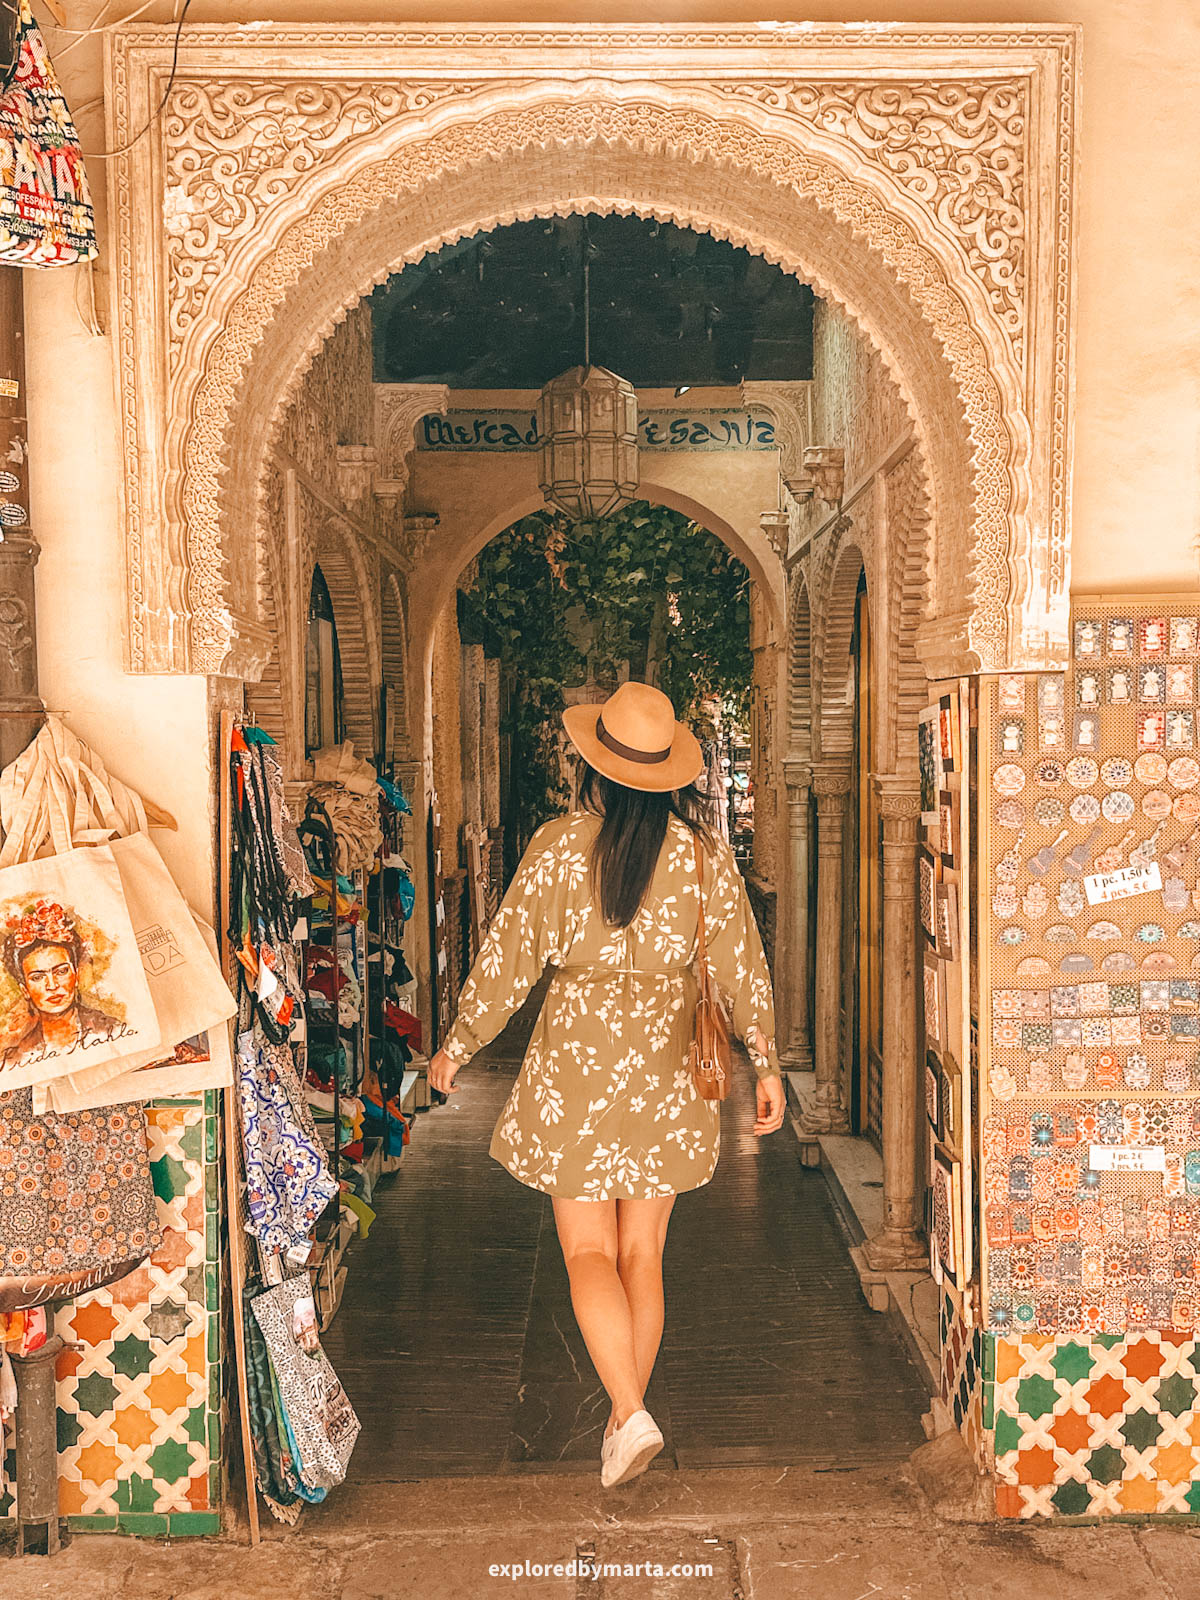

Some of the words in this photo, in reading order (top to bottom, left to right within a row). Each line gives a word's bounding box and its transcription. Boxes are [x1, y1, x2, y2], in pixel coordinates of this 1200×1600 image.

[1093, 878, 1098, 887] 1
[1102, 876, 1118, 888] pc.
[1121, 869, 1142, 881] 1,50
[1101, 890, 1107, 900] 4
[1111, 886, 1131, 900] pcs.
[1133, 883, 1140, 893] 5
[1143, 880, 1150, 890] €
[0, 1046, 61, 1073] Frida
